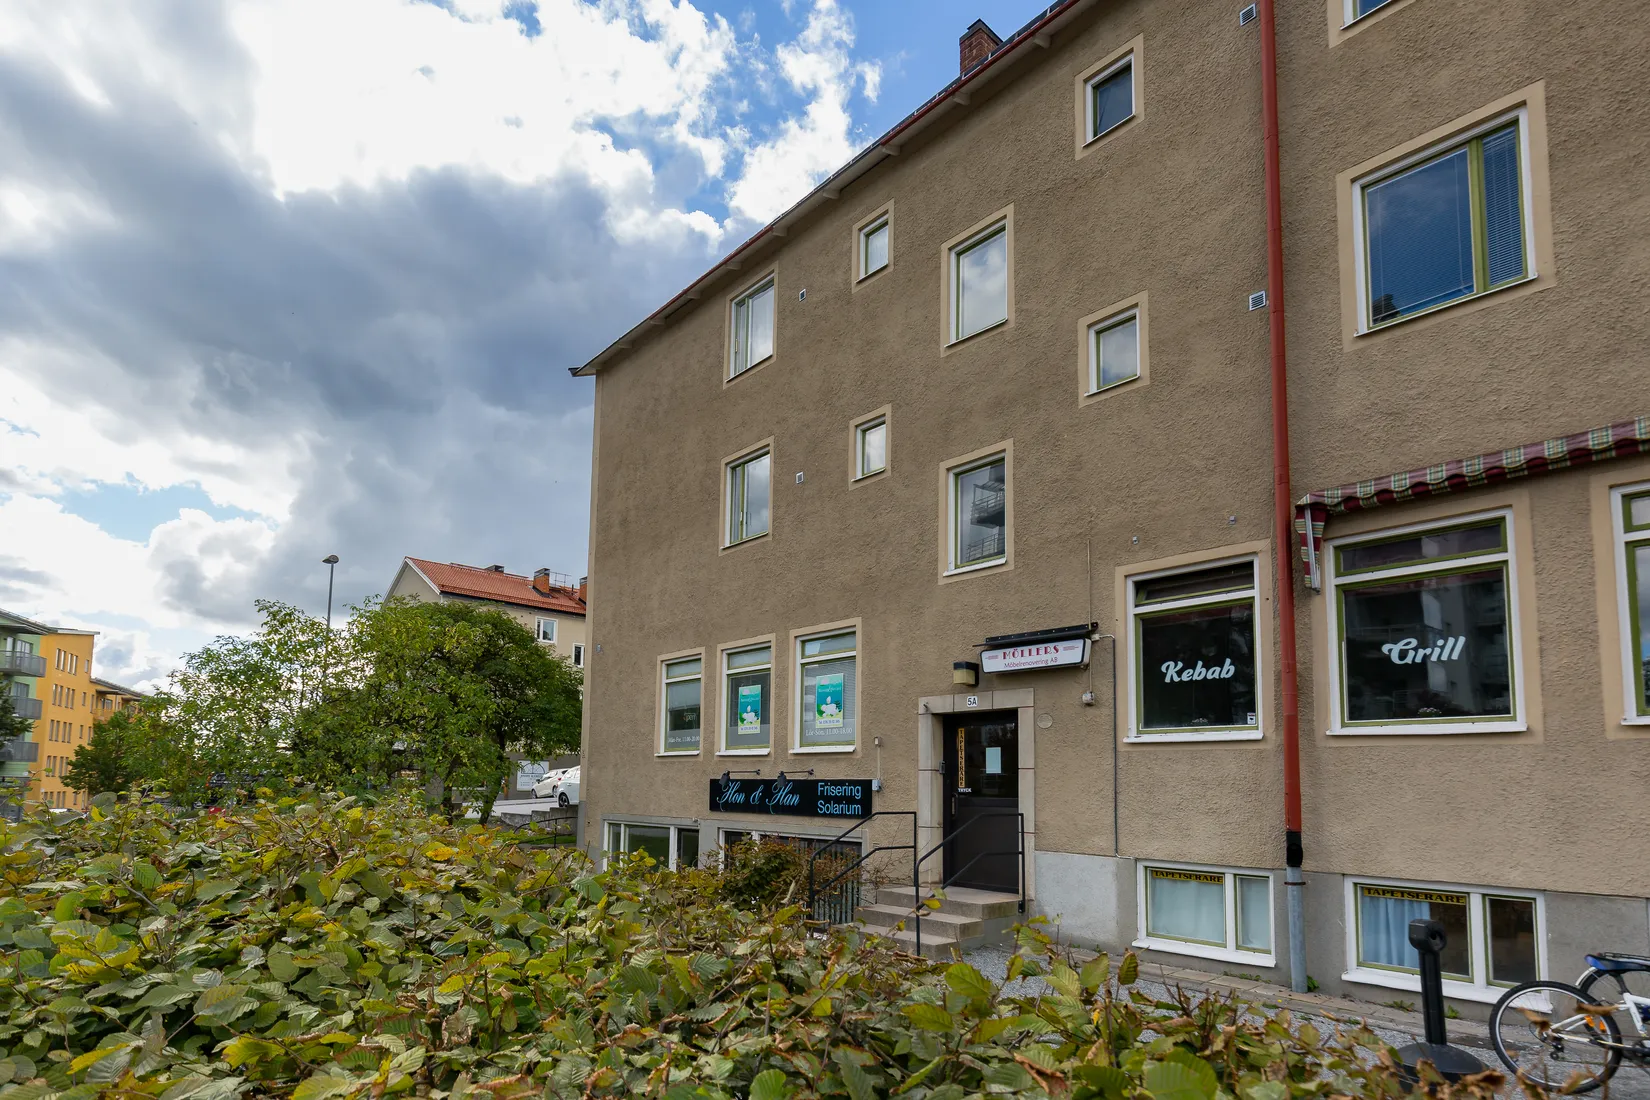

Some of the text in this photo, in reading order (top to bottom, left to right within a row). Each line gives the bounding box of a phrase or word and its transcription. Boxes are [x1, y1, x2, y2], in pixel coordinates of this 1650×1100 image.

[1002, 645, 1059, 660] MÖLLERS
[1381, 635, 1466, 664] Grill
[1004, 658, 1049, 669] Möbelrenovering
[1161, 658, 1236, 683] Kebab
[967, 697, 977, 706] 5A
[716, 781, 800, 815] Hon & Han
[817, 782, 862, 800] Frisering
[817, 800, 862, 815] Solarium
[1153, 870, 1224, 883] TAPETSERARE
[1366, 887, 1465, 904] TAPETSERARE
